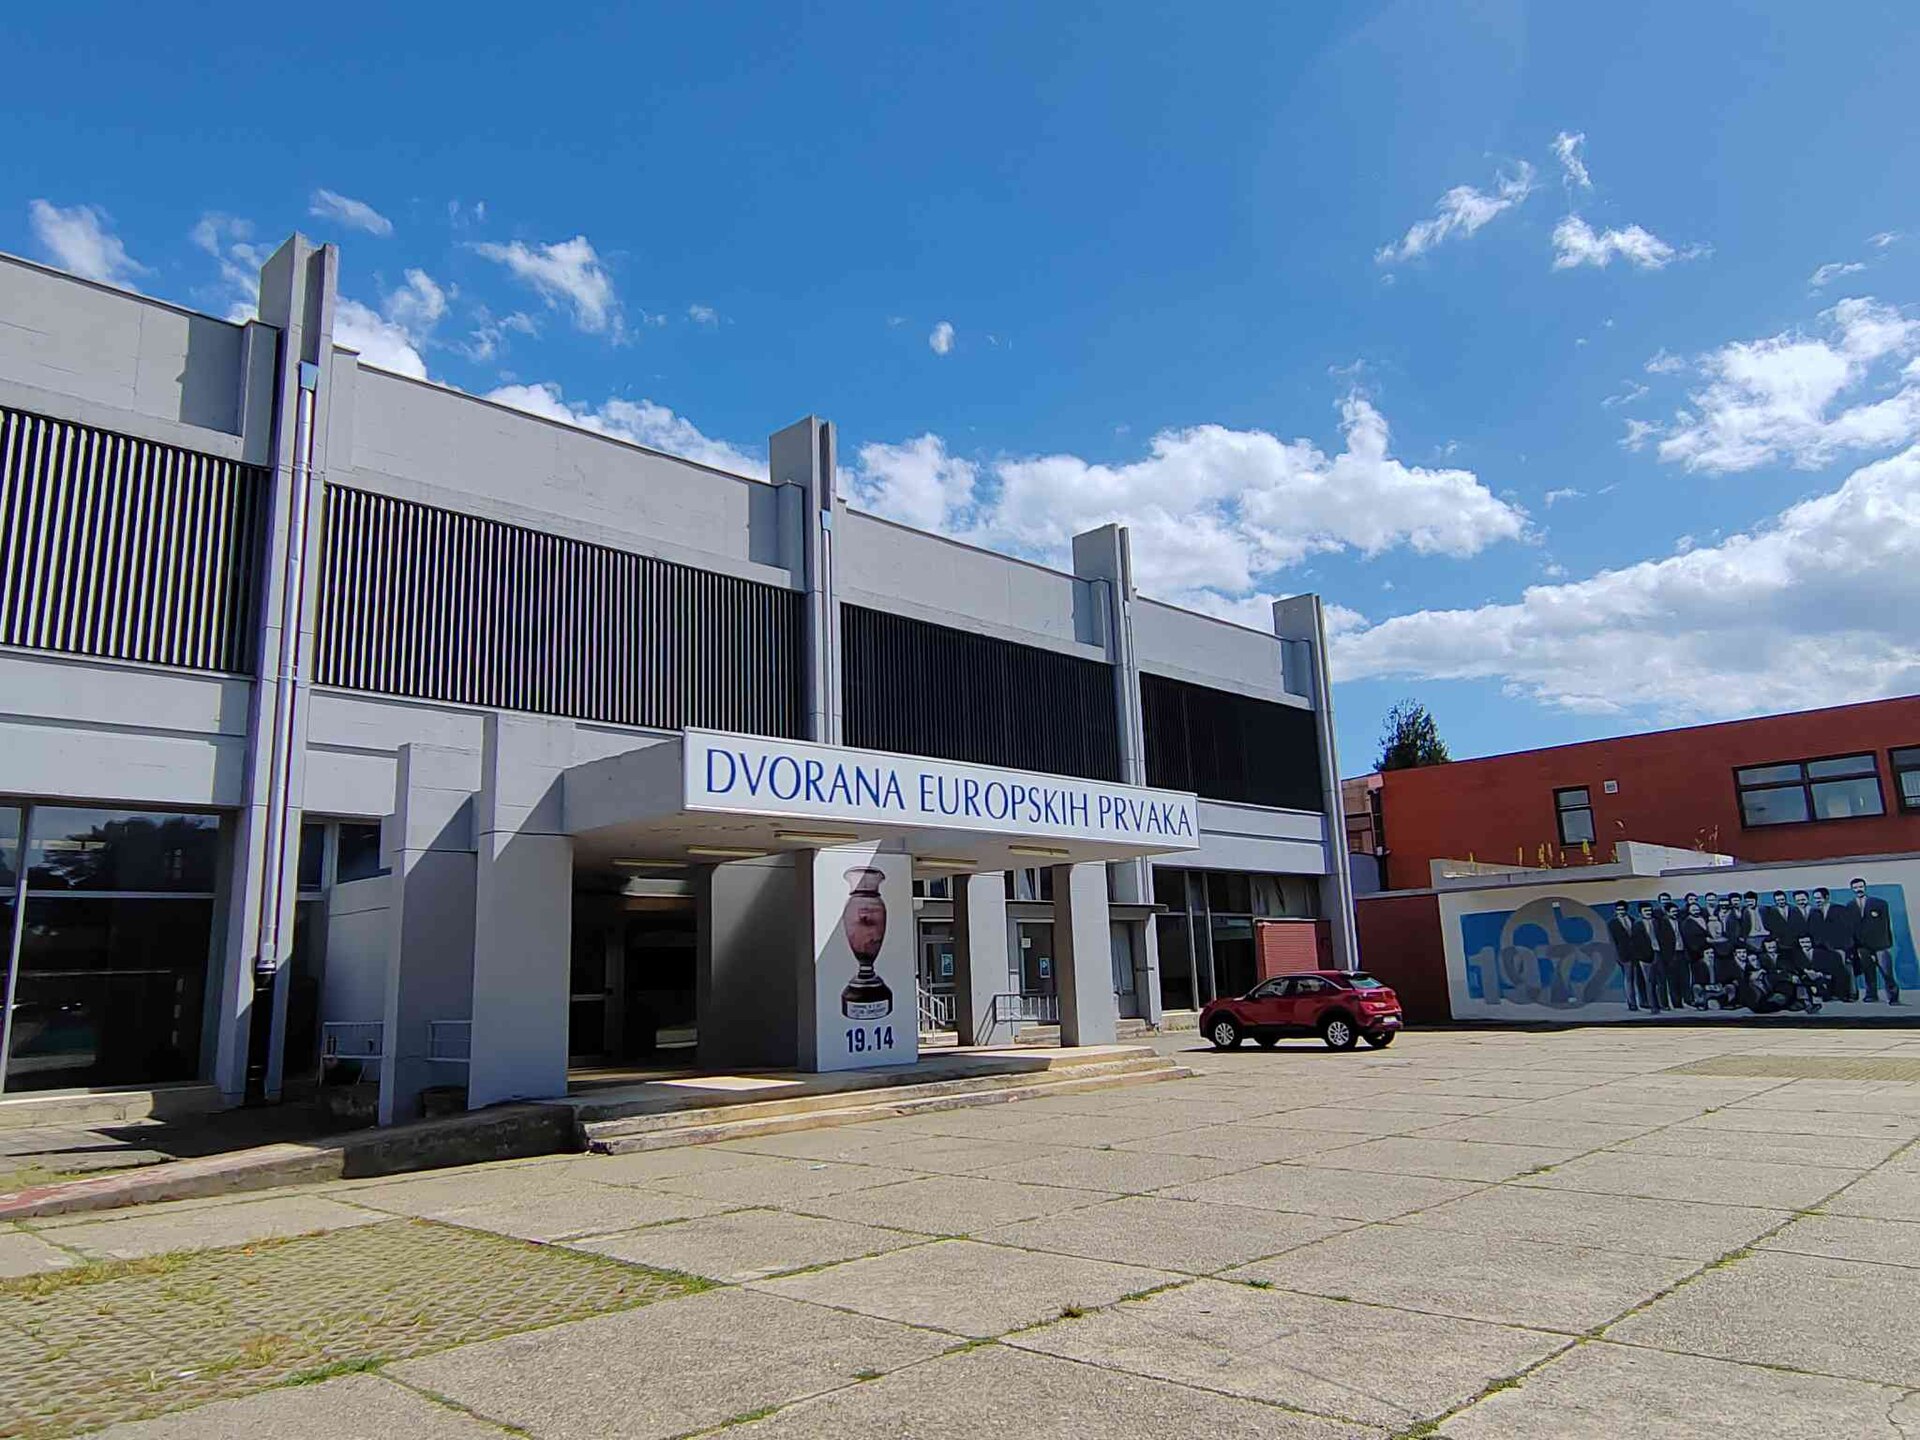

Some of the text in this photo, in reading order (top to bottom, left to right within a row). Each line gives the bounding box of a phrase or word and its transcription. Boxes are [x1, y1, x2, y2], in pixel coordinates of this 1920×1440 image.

[706, 748, 1193, 837] DVORANA EUROPSKIH PRVAKA
[846, 1026, 894, 1053] 19.14
